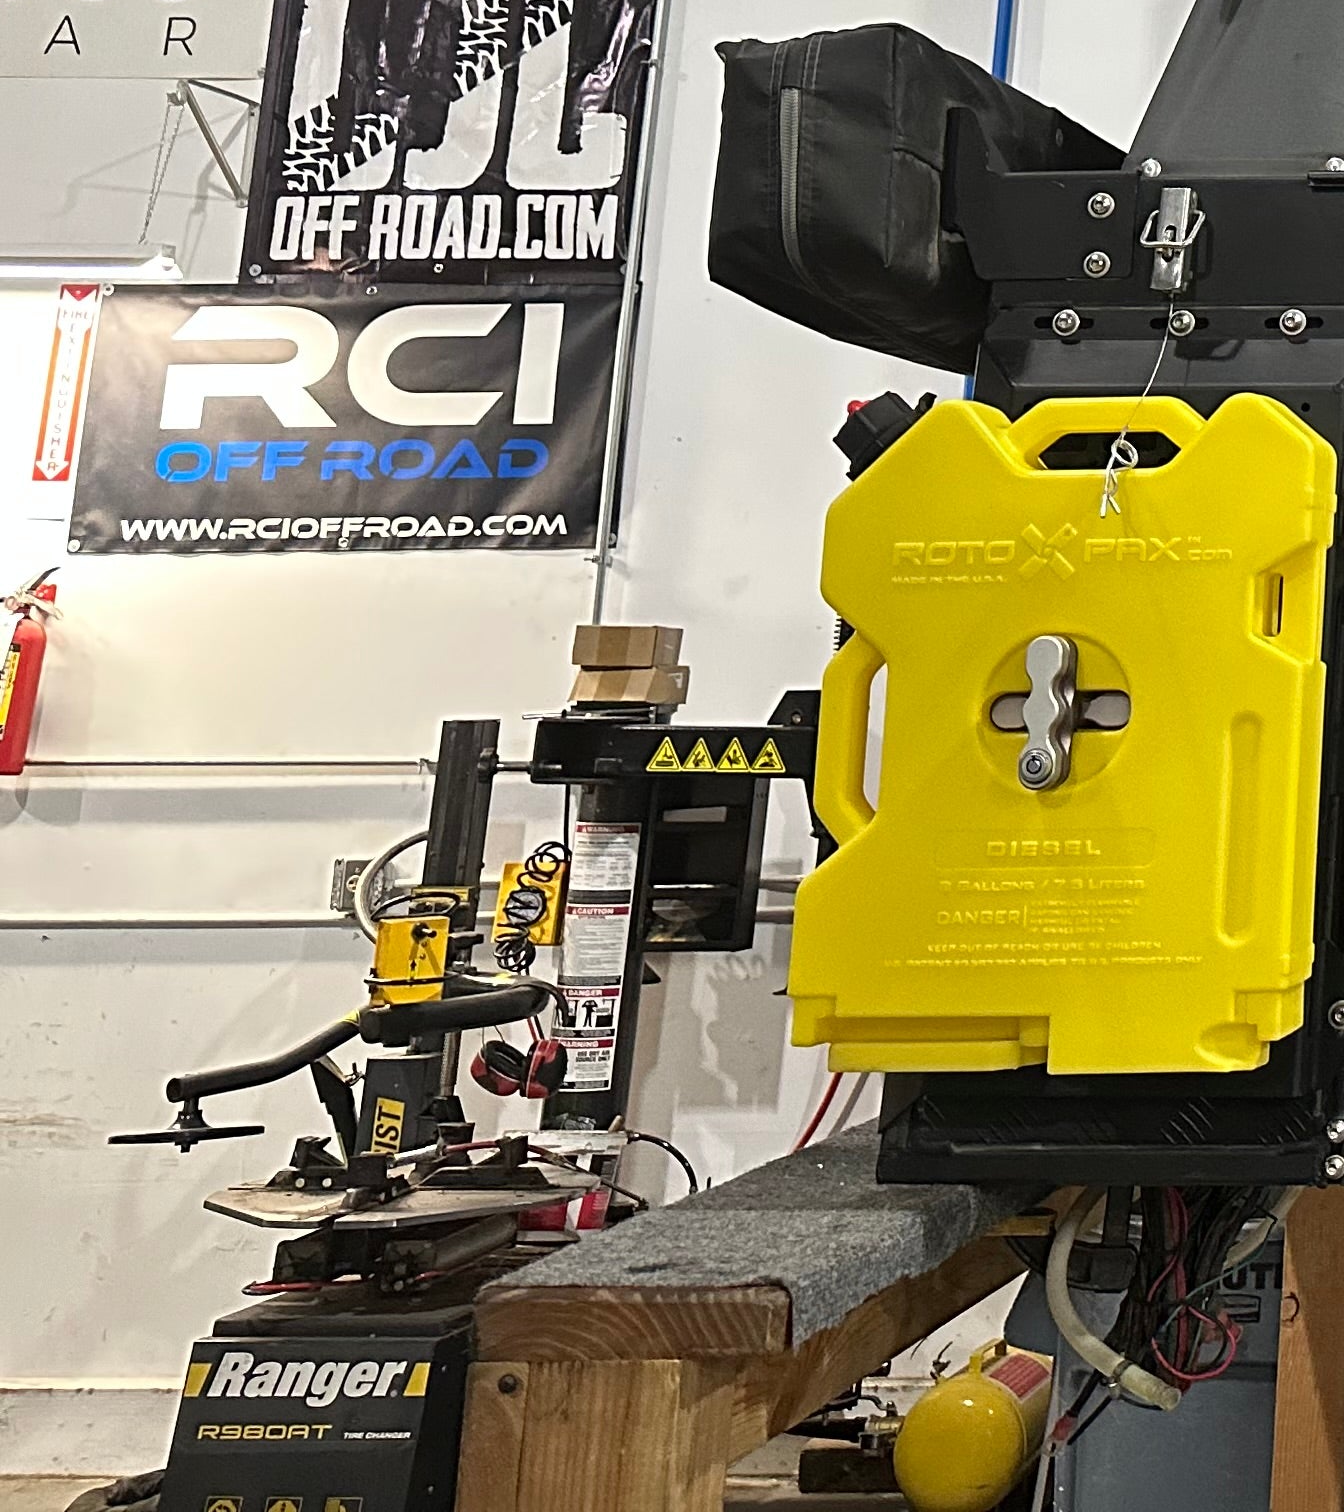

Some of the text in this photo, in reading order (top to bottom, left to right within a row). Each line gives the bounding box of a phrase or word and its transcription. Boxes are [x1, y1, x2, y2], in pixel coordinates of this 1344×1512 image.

[270, 195, 620, 260] OFF ROAD.COM
[159, 303, 566, 429] RCI
[154, 439, 549, 483] OFF ROAD
[120, 513, 568, 542] WWW.RCIOFFROAD.COM
[893, 540, 1016, 566] ROTO
[1084, 537, 1182, 563] PAX
[986, 840, 1101, 857] DIESEL
[577, 907, 614, 916] CAUTION
[937, 910, 1021, 926] DANGER
[374, 1105, 401, 1152] IST
[207, 1352, 407, 1407] Ranger
[197, 1424, 411, 1440] R980AT TIRE CHANGER
